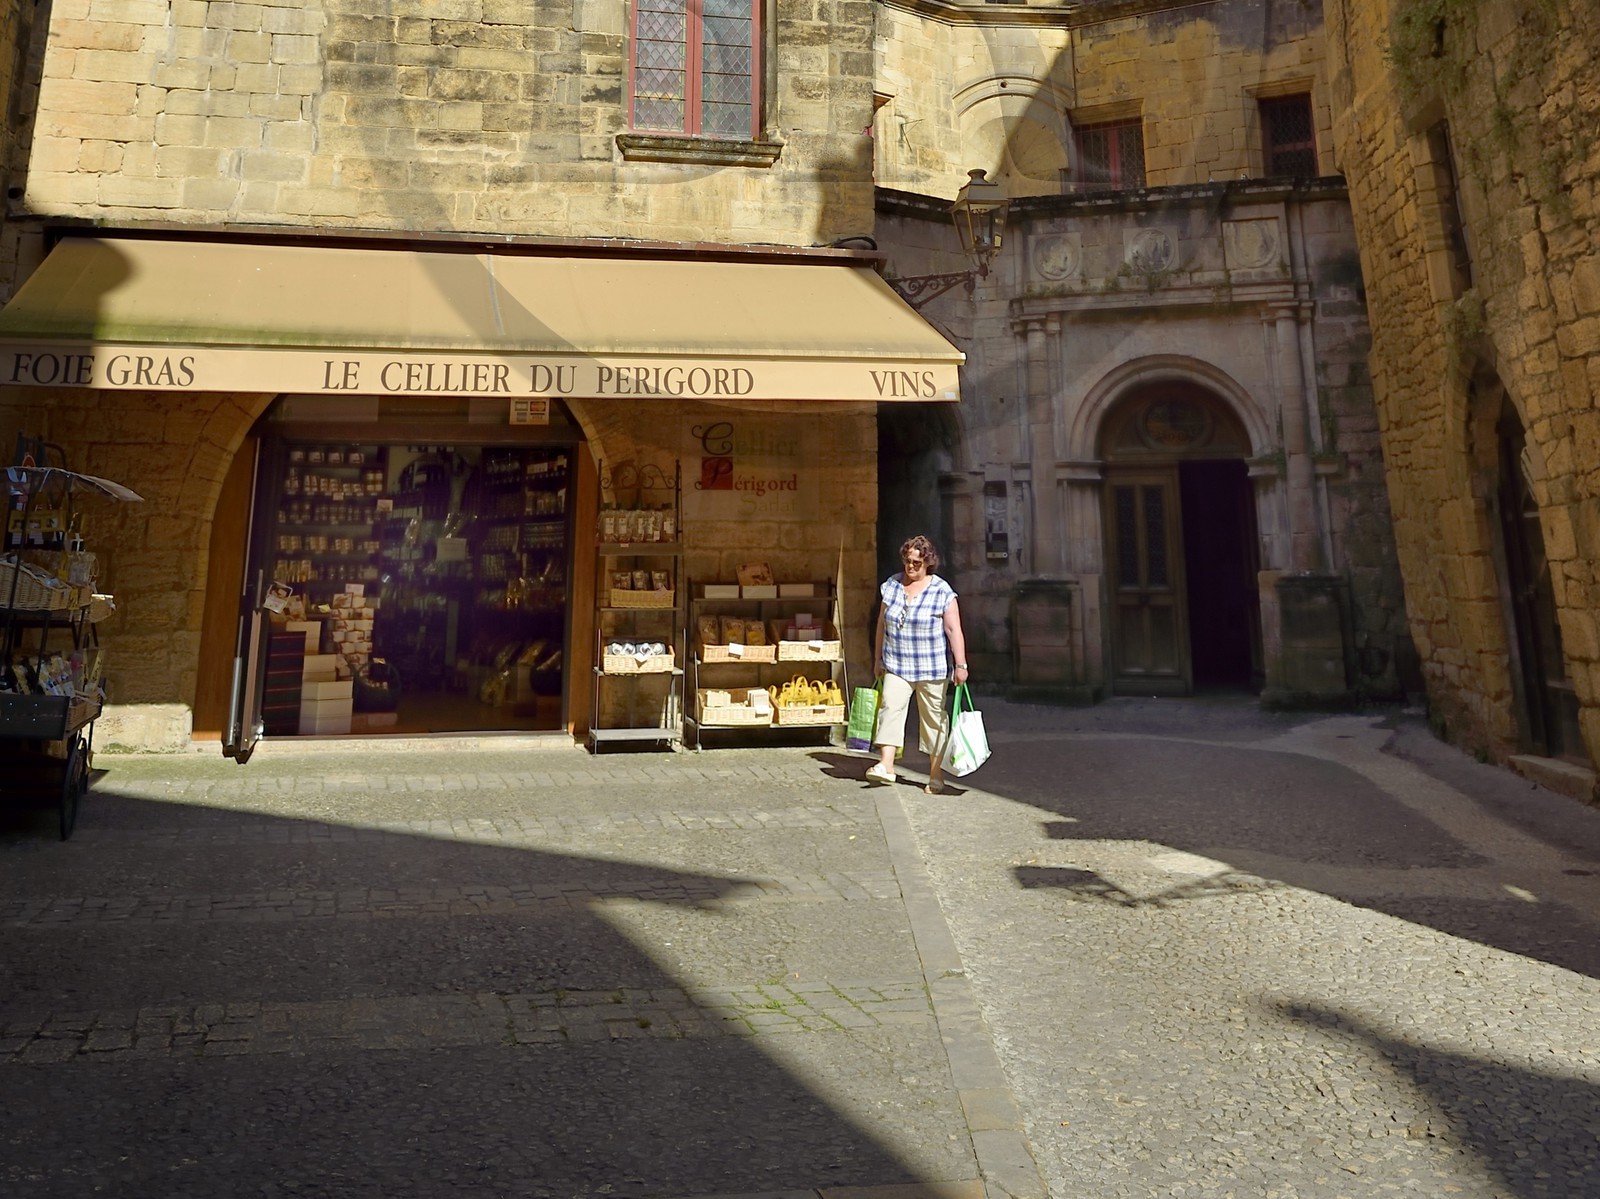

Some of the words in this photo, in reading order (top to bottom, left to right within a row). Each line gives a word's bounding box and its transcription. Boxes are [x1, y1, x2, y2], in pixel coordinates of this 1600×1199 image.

[9, 353, 95, 385] FOIE
[106, 354, 195, 387] GRAS
[321, 360, 361, 390] LE
[380, 361, 512, 393] CELLIER
[529, 364, 578, 394] DU
[595, 366, 754, 396] PERIGORD
[868, 370, 937, 398] VINS
